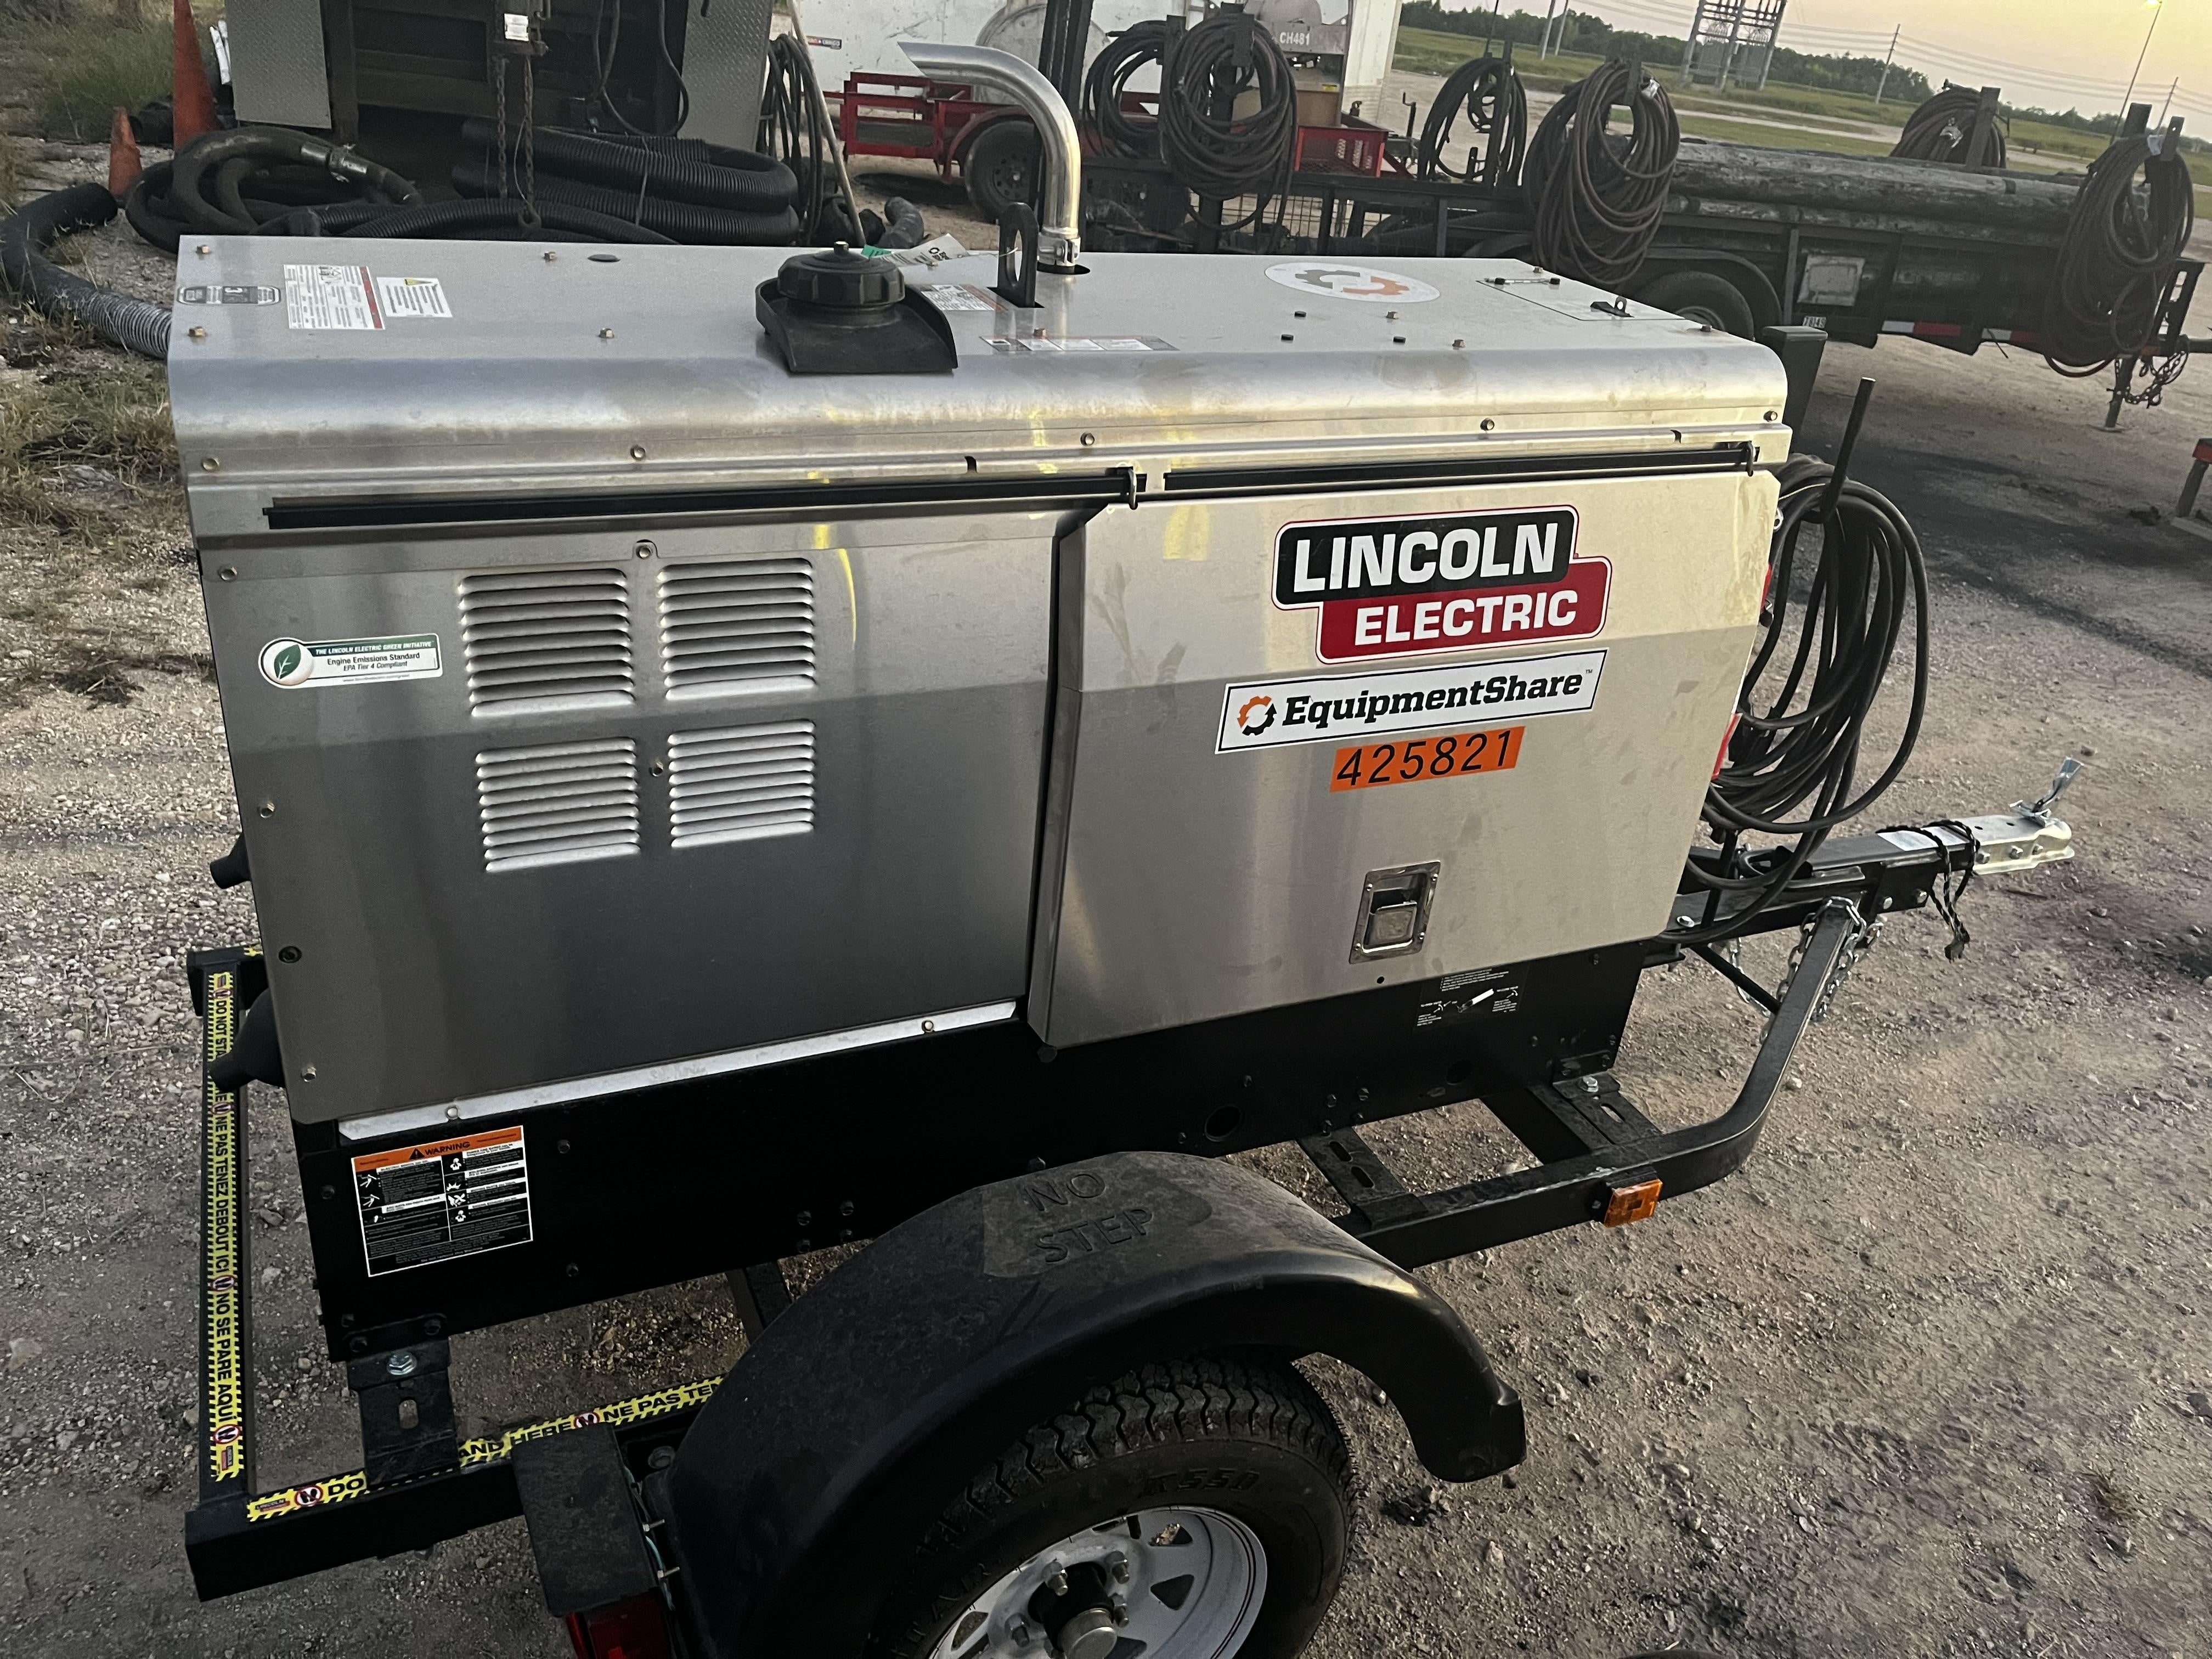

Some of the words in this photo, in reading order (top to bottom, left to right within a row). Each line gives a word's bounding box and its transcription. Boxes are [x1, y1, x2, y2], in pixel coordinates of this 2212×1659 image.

[1279, 31, 1310, 46] CH481
[1293, 522, 1559, 593] LINCOLN
[1354, 589, 1578, 646] ELECTRIC
[327, 657, 351, 666] Engine
[1335, 730, 1511, 786] 425821
[216, 1000, 227, 1014] DO
[216, 1015, 227, 1035] NOT
[215, 1038, 227, 1058] STA
[216, 1116, 228, 1132] NE
[216, 1134, 228, 1156] PAS
[424, 1141, 471, 1155] WARNING
[216, 1158, 228, 1198] TENEZ
[1024, 1172, 1107, 1212] NO
[216, 1200, 229, 1252] DEBOUT
[1035, 1209, 1154, 1263] STEP
[216, 1255, 229, 1273] ICI
[216, 1293, 230, 1316] NO
[216, 1317, 231, 1337] SE
[217, 1339, 232, 1381] PARE
[603, 1404, 634, 1421] NE
[637, 1393, 681, 1412] PAS
[328, 1478, 364, 1496] DO
[459, 1441, 504, 1458] AND
